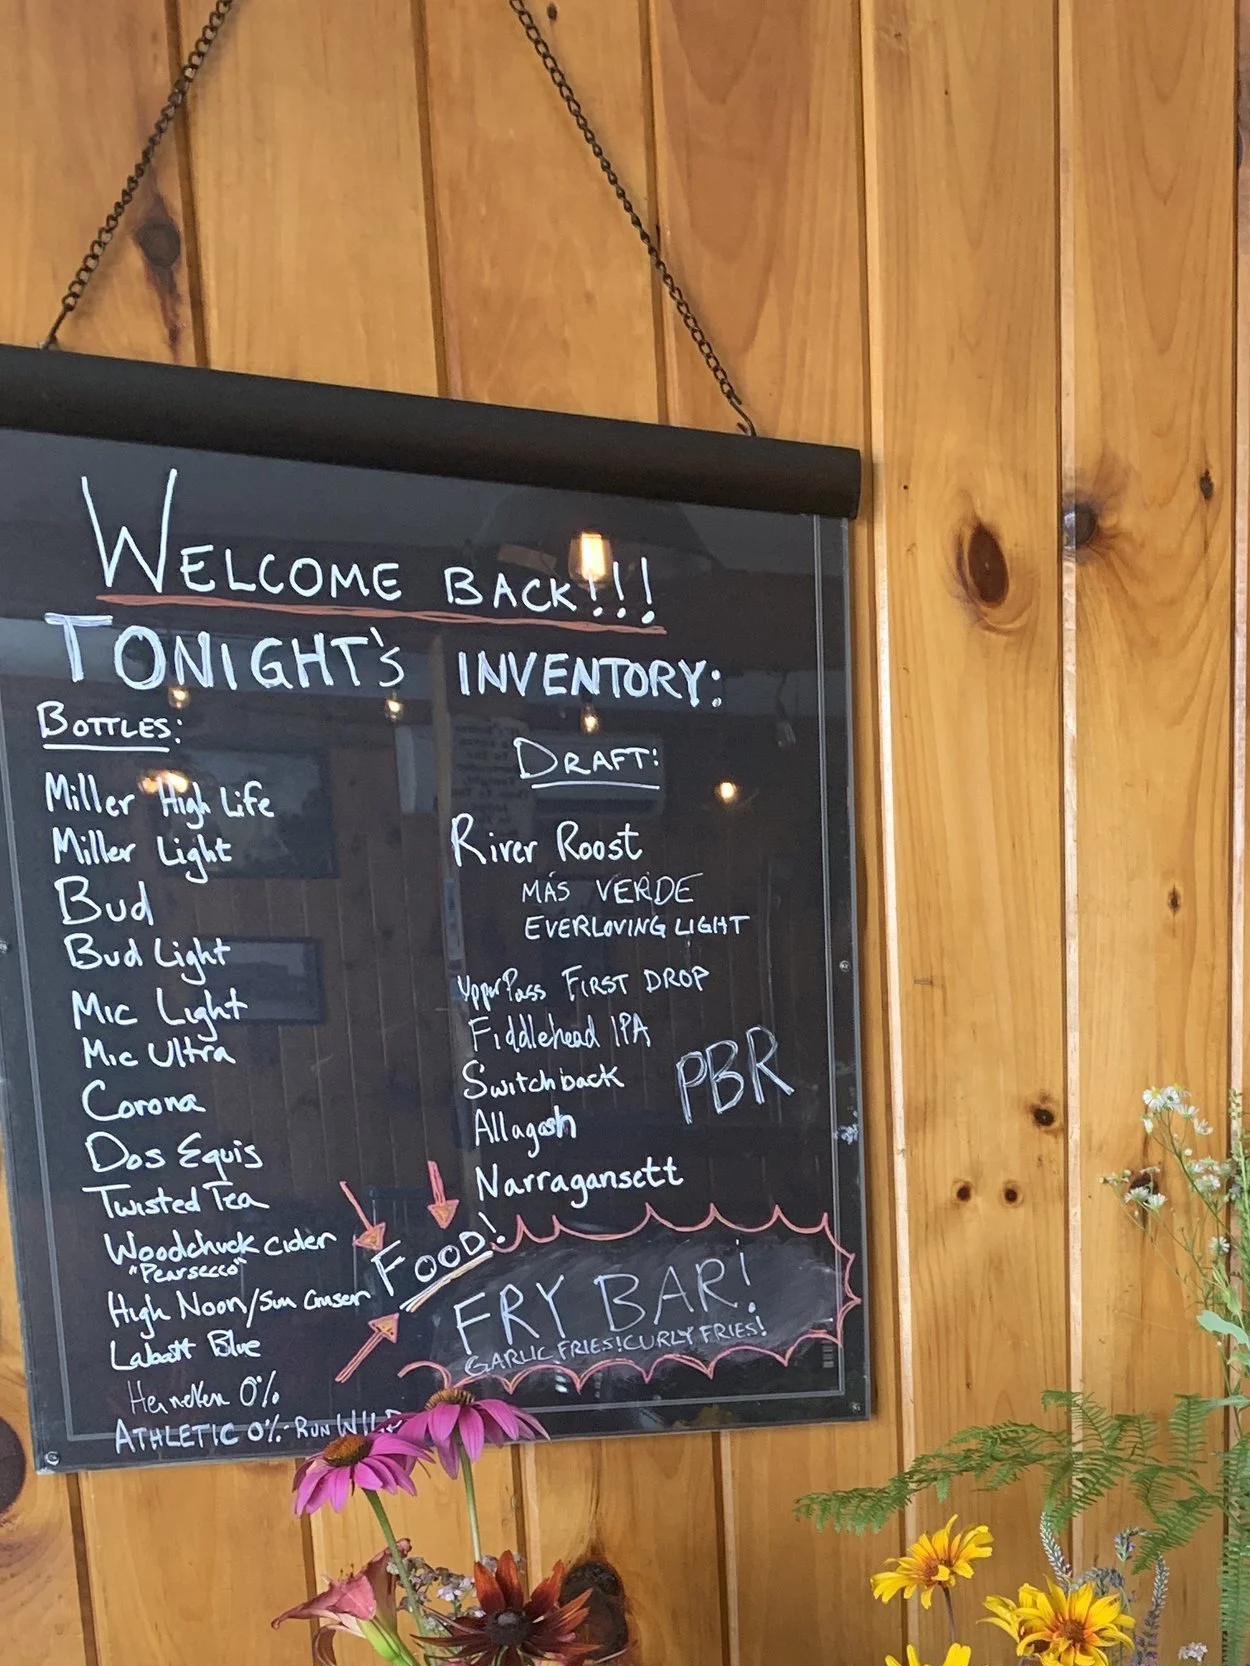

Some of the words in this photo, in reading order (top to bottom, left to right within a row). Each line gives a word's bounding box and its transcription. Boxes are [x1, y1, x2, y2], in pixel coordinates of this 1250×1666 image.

[81, 468, 402, 600] WELCOME
[444, 557, 655, 624] BACK!!!
[458, 651, 722, 707] INVENTORY:
[37, 700, 182, 744] BOTTLES:
[513, 736, 660, 779] DRAFT:
[45, 772, 135, 817] Miller
[157, 776, 211, 830] High
[220, 781, 275, 817] Life
[52, 827, 136, 866] Miller
[157, 834, 232, 884] Light
[450, 813, 538, 867] River
[556, 820, 644, 862] Roost
[54, 875, 154, 926] Bud
[596, 872, 703, 906] VERDE
[524, 915, 667, 940] EVERLOVING
[675, 915, 750, 936] LIGHT
[63, 933, 144, 970] Bud
[154, 937, 231, 985] Light
[562, 965, 630, 1002] FIRST
[644, 966, 710, 994] DROP
[72, 990, 137, 1031] Mic
[157, 987, 248, 1041] Light
[468, 1013, 600, 1054] Fiddlehead
[611, 1012, 652, 1048] IPA
[82, 1037, 138, 1068] Mic
[148, 1037, 236, 1068] Ultra
[675, 1025, 795, 1126] PBR
[81, 1079, 206, 1121] Corona
[462, 1059, 625, 1100] Switchback
[85, 1131, 166, 1173] Dos
[177, 1132, 263, 1181] Equis
[474, 1105, 577, 1158] Allagash
[82, 1183, 200, 1219] Twisted
[202, 1180, 270, 1210] Tea
[475, 1156, 684, 1209] Narragansett
[104, 1229, 260, 1265] Woodchuck
[370, 1212, 506, 1297] FOOD!
[108, 1290, 171, 1340] High
[453, 1274, 566, 1356] FRY
[593, 1242, 757, 1333] BAR!
[109, 1338, 196, 1370] Labatt
[207, 1329, 261, 1358] Blue
[464, 1344, 555, 1377] GARLIC
[623, 1329, 695, 1351] CURLY
[699, 1316, 767, 1343] FRIES!
[114, 1419, 238, 1454] ATHLETIC
[296, 1414, 330, 1438] RUN
